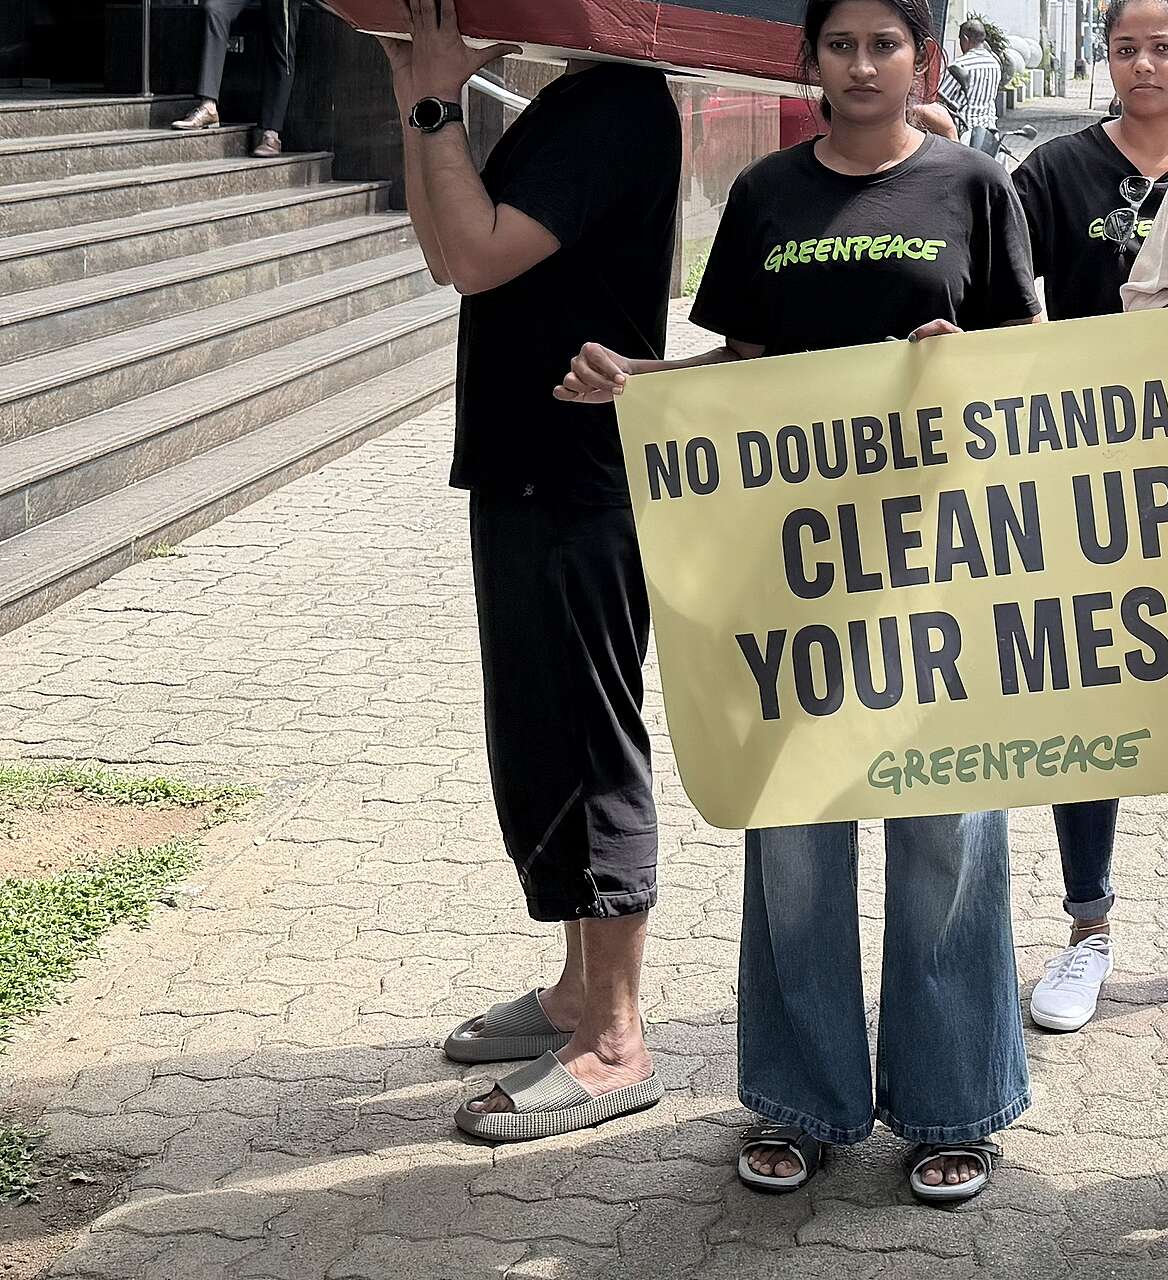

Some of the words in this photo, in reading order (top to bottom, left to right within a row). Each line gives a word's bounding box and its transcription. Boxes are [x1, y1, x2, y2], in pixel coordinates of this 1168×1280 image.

[763, 234, 947, 273] GREENPEACE
[645, 436, 719, 500] NO
[737, 407, 948, 489] DOUBLE
[781, 481, 1045, 599] CLEAN
[735, 611, 968, 721] YOUR
[867, 728, 1152, 795] GREENPEACE
